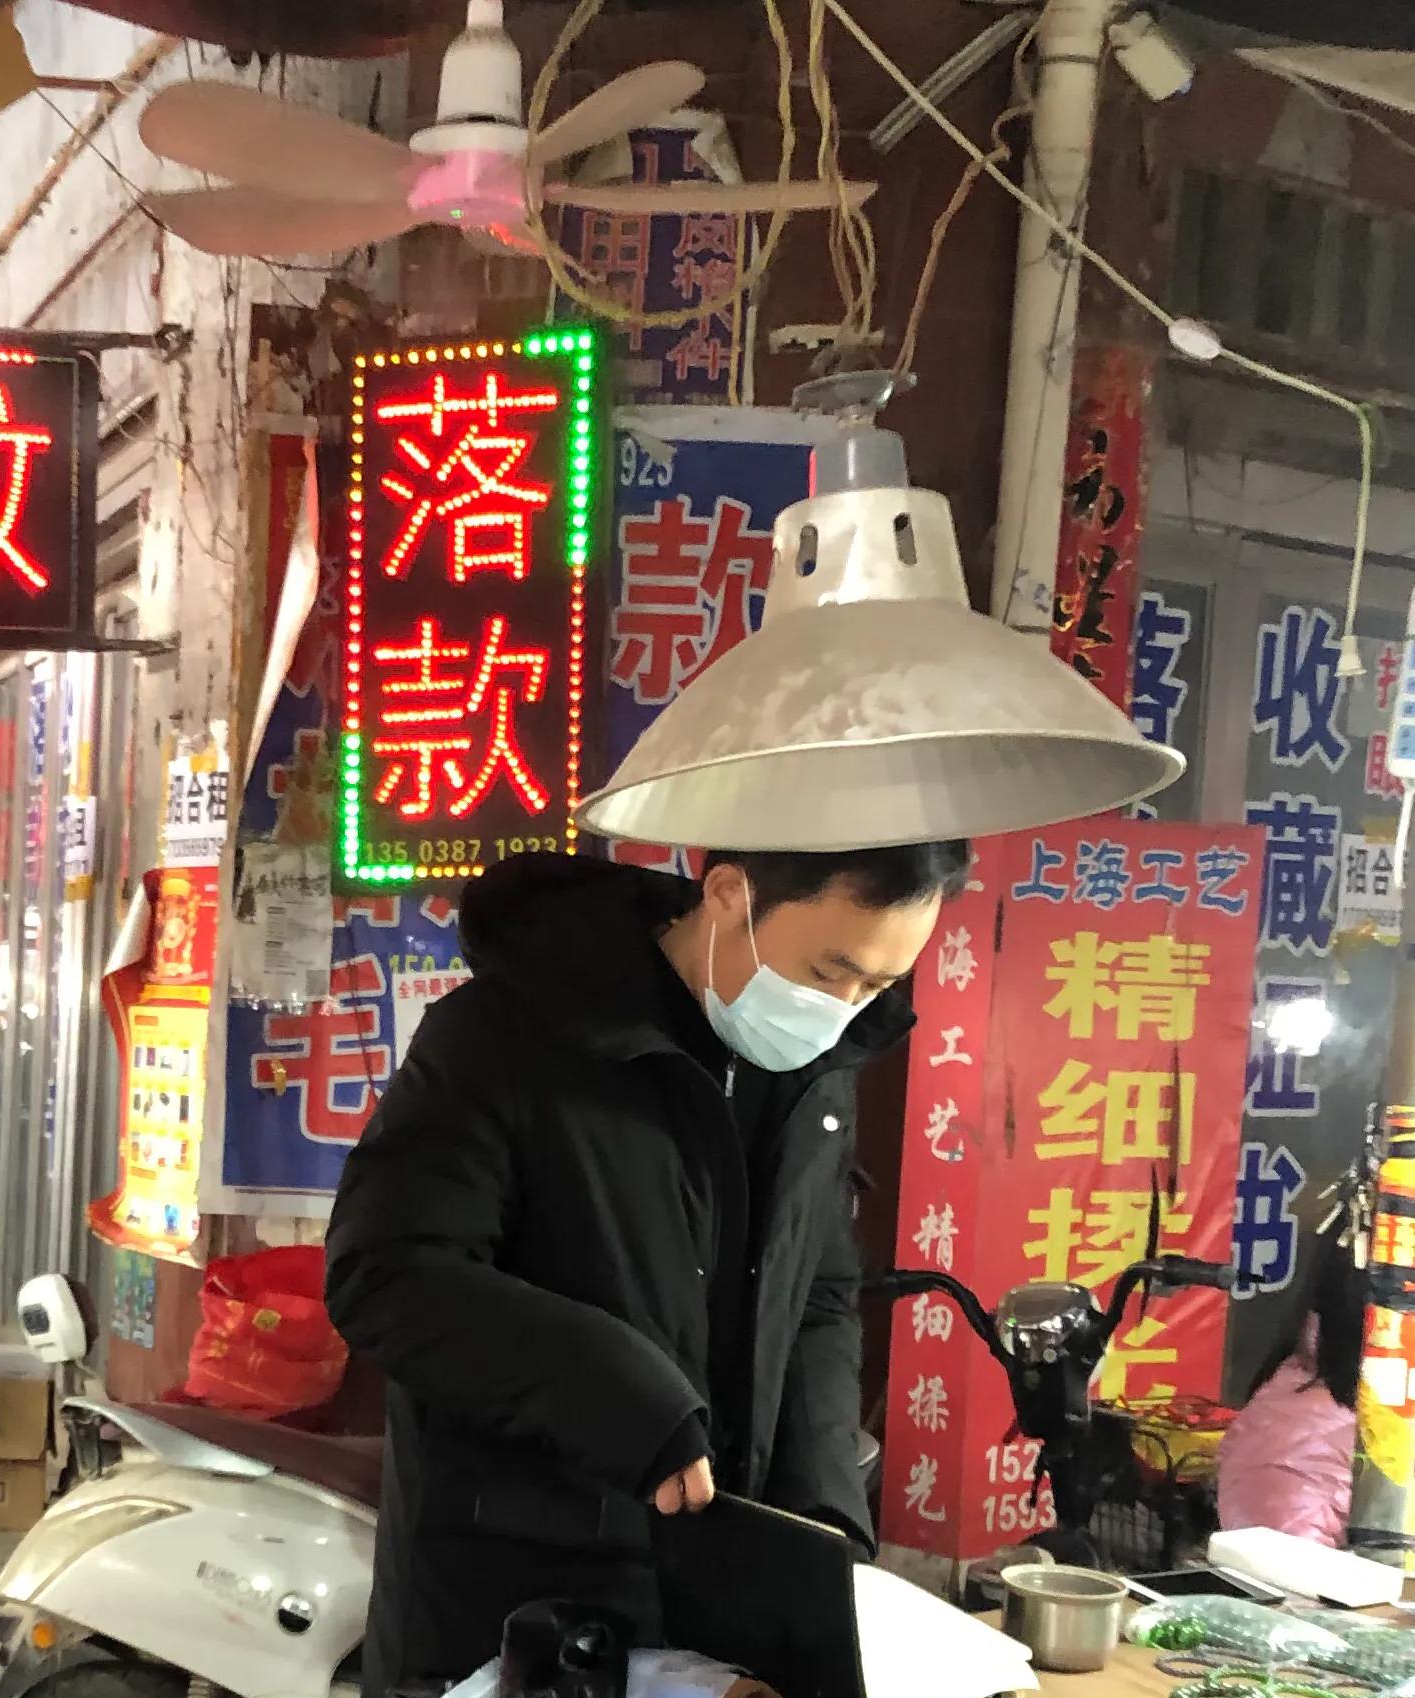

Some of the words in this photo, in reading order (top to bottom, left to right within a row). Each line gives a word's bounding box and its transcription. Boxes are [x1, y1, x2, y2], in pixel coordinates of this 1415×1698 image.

[372, 371, 558, 820] 落款
[365, 840, 409, 863] 135
[419, 838, 482, 863] 0387
[1011, 837, 1251, 917] 上海工艺
[985, 1441, 1049, 1484] 152
